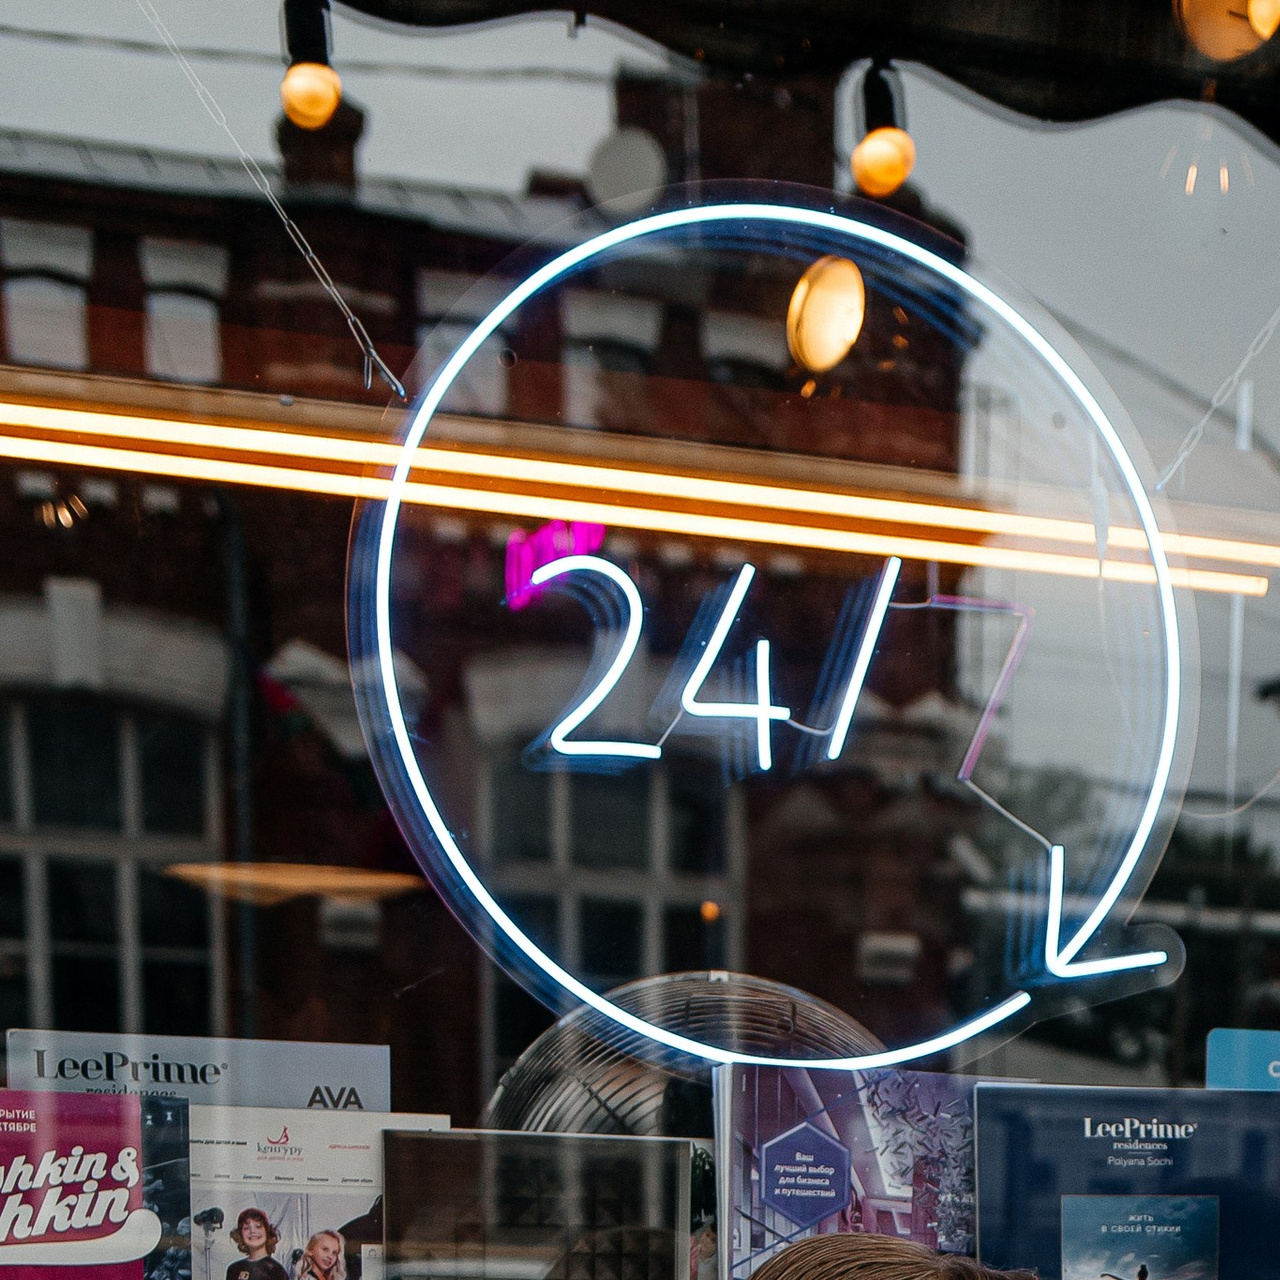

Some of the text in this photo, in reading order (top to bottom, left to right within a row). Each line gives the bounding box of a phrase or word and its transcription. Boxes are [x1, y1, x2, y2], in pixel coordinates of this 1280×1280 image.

[33, 1049, 221, 1085] LeePrime
[306, 1085, 365, 1110] AVA
[1083, 1117, 1195, 1139] LeePrime
[1113, 1139, 1168, 1150] residences
[795, 1152, 814, 1161] Ваш
[1107, 1156, 1174, 1167] Polyana Sochi
[0, 1145, 140, 1193] hkin &
[774, 1164, 835, 1175] лучший выбор
[778, 1175, 830, 1185] для бизнеса
[782, 1188, 836, 1197] путешествий
